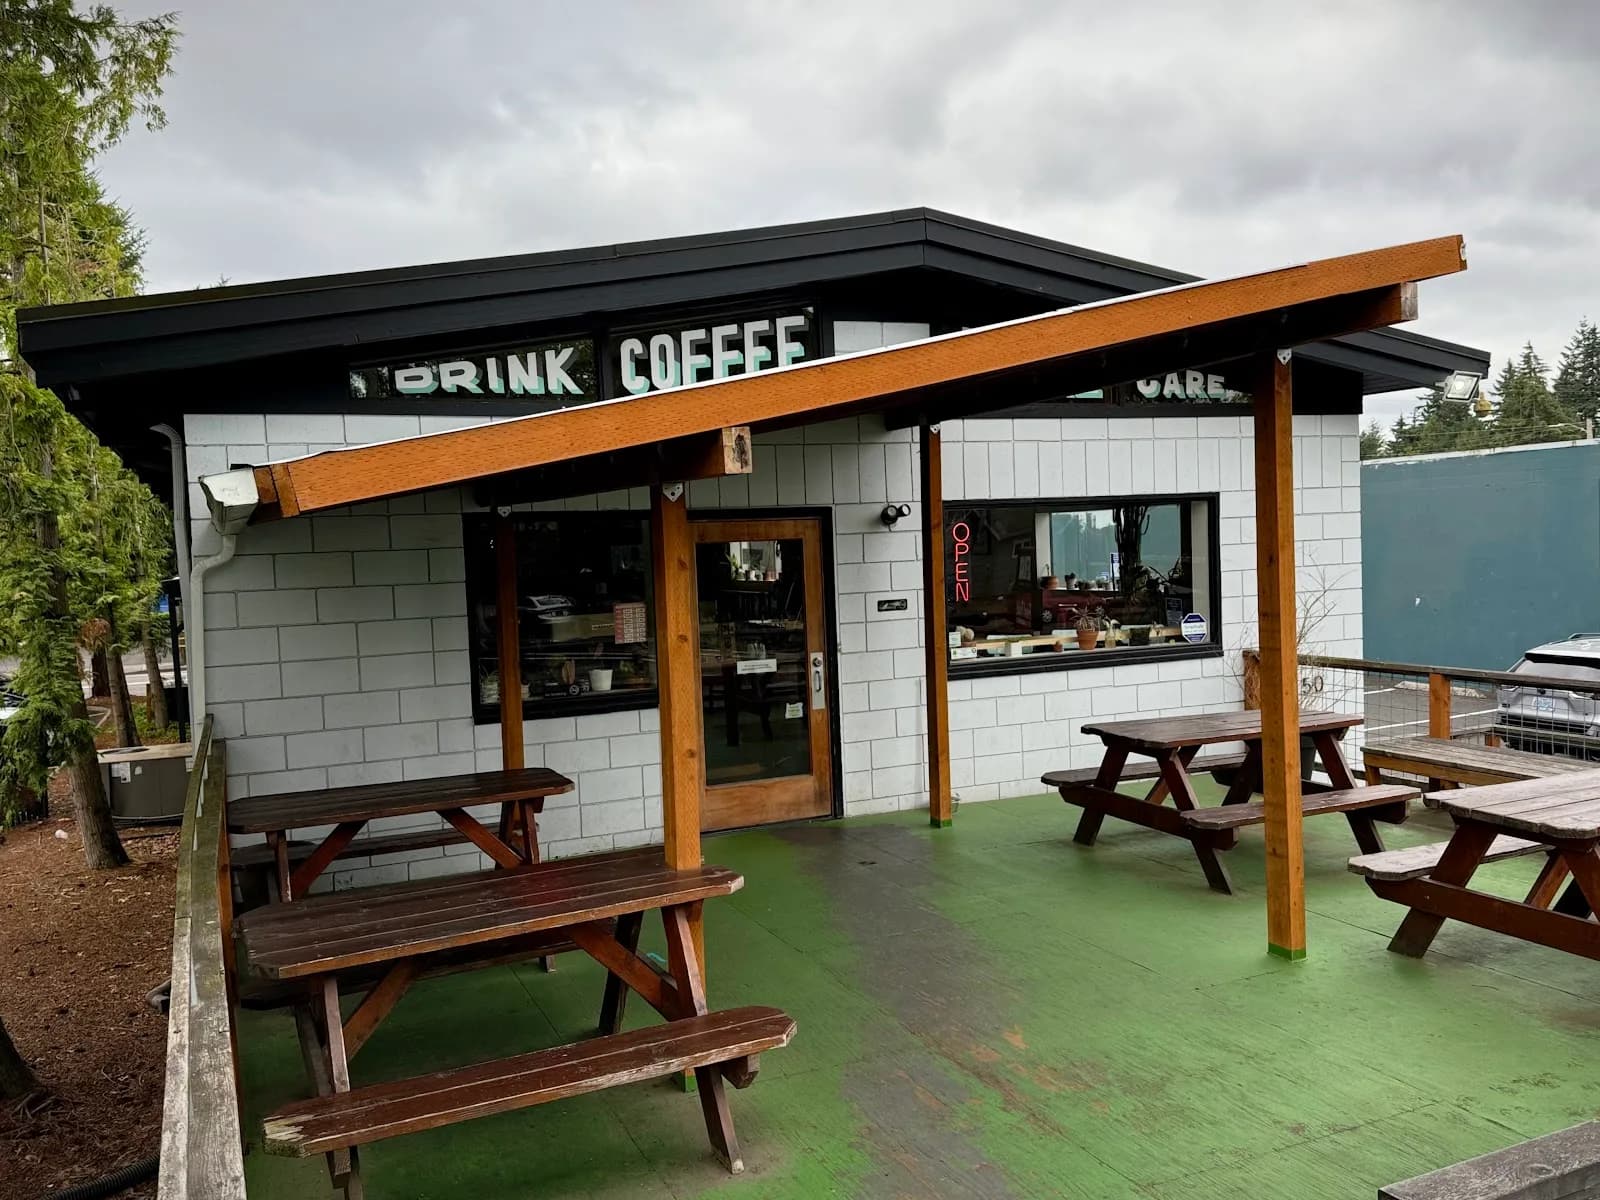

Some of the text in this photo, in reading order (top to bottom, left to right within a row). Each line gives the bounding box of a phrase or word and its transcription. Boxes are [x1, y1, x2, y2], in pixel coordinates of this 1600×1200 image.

[394, 315, 809, 395] DRINK COFFEE
[952, 522, 970, 602] OPEN
[1303, 675, 1324, 690] 50
